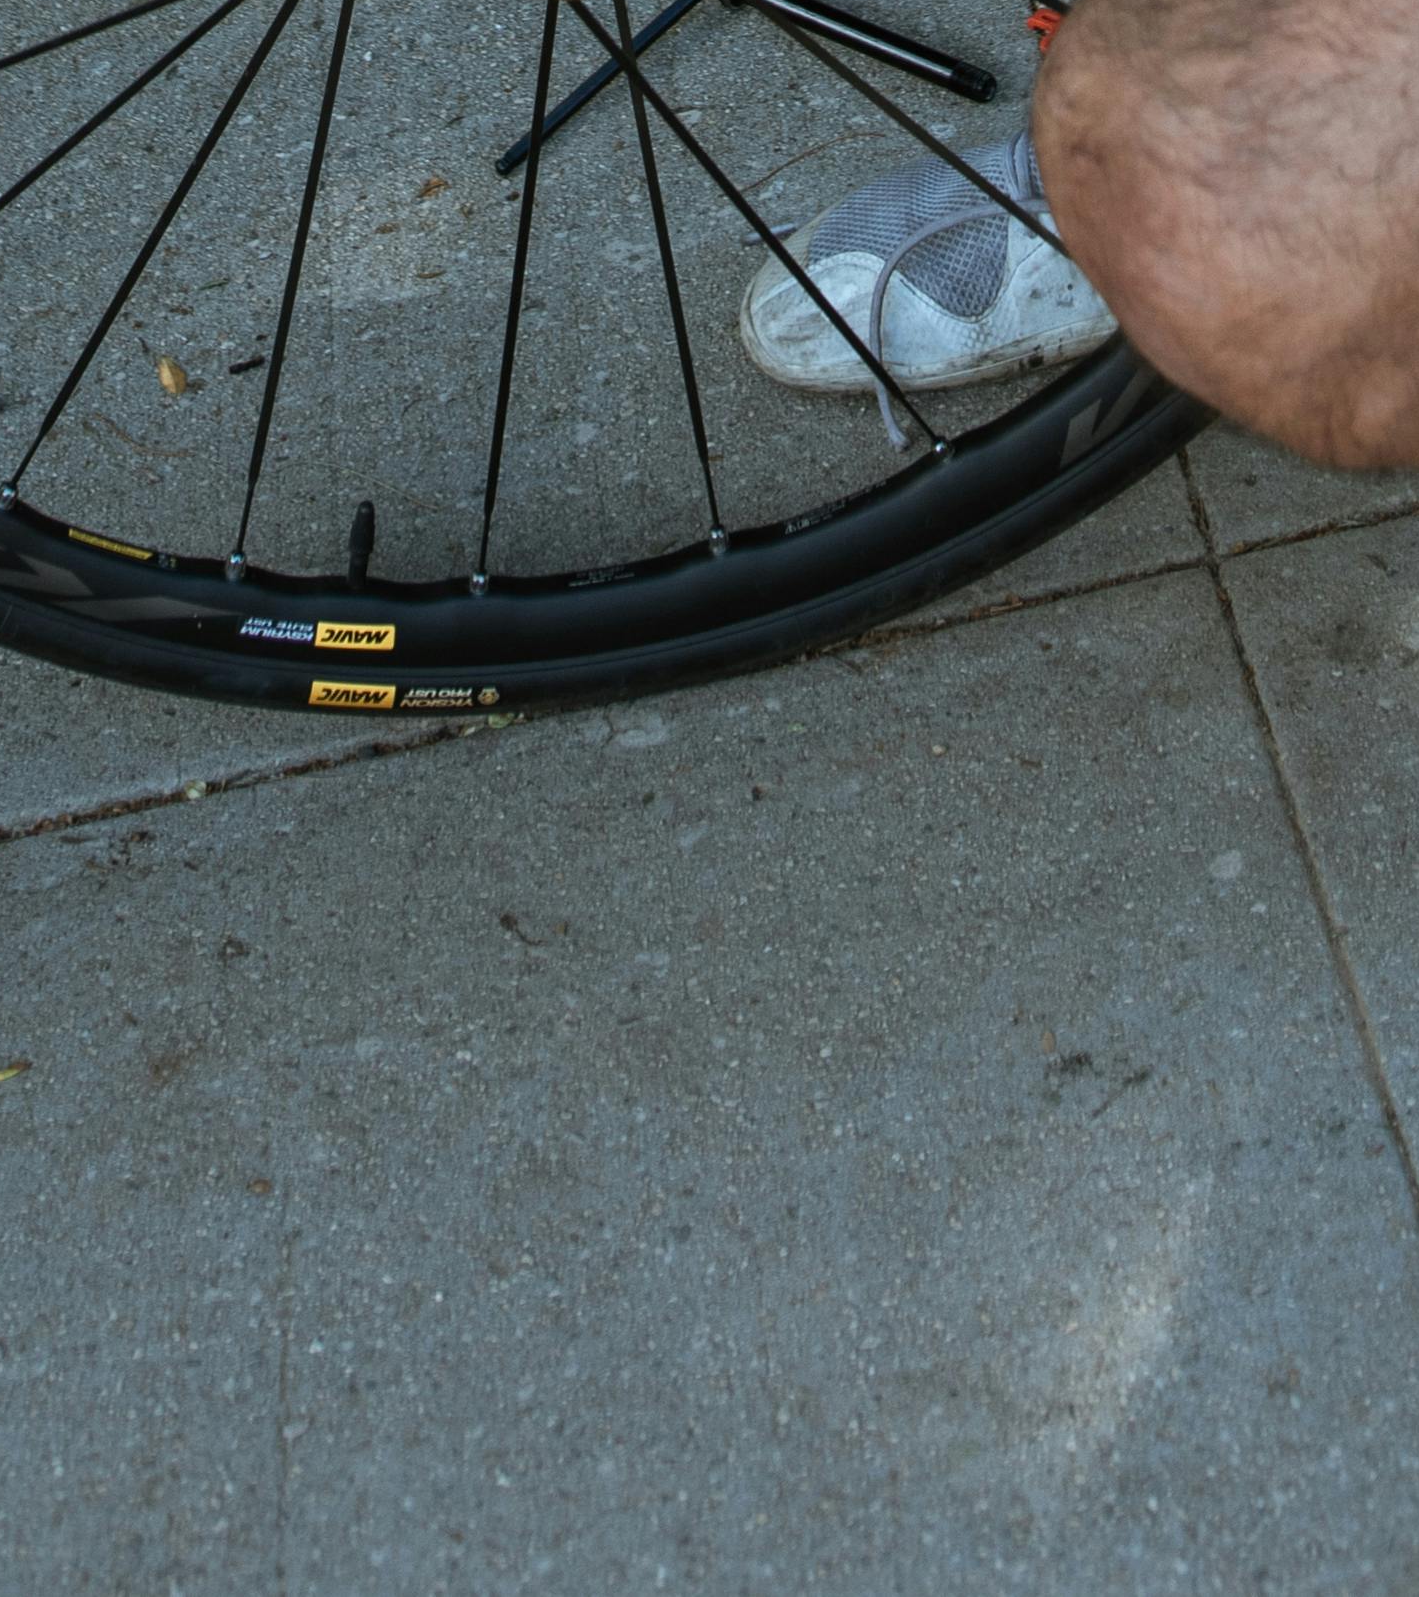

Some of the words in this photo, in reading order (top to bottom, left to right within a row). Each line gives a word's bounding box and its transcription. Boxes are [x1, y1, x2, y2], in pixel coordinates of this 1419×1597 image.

[239, 625, 314, 641] KSYRIUM
[320, 628, 390, 644] MAVIC
[316, 687, 390, 705] MAVIC
[404, 686, 438, 698] UST
[438, 687, 473, 699] PRO
[399, 697, 474, 708] YKSION
